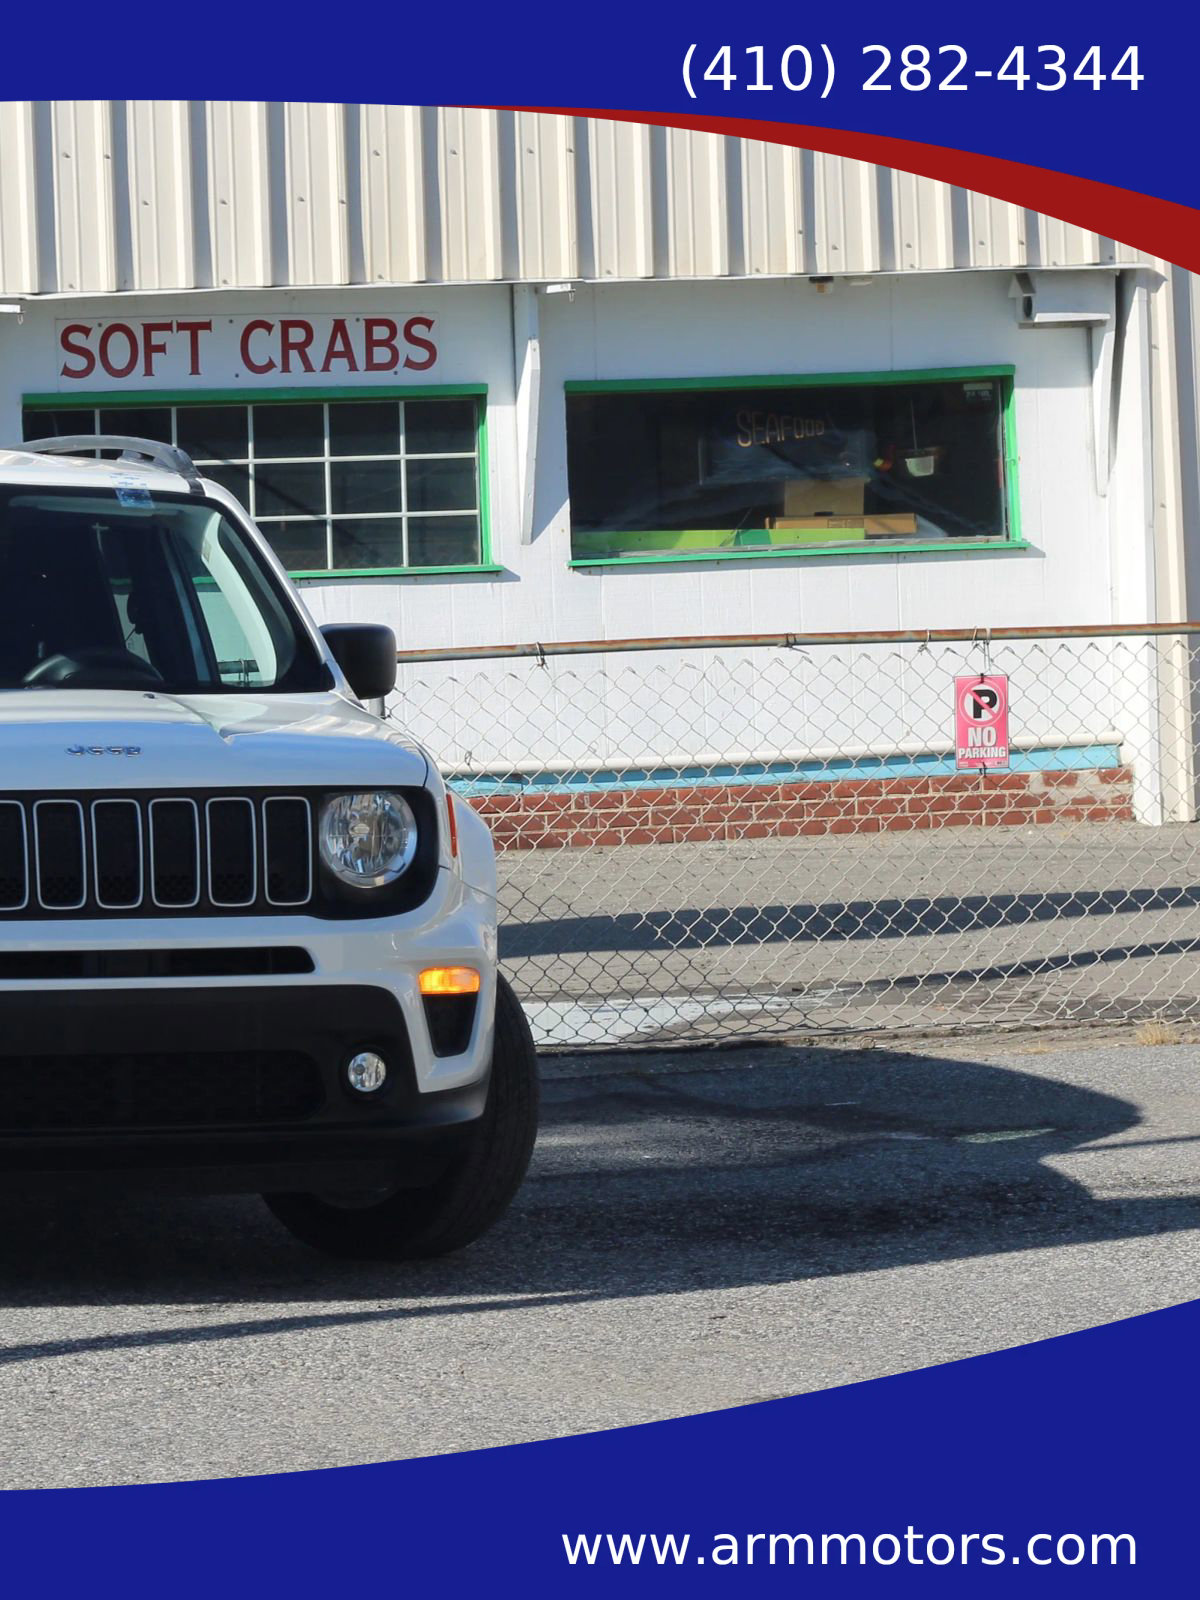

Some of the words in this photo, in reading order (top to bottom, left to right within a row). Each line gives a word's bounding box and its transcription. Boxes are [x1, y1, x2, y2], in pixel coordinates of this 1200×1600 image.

[60, 319, 213, 379] SOFT
[240, 316, 438, 375] CRABS
[967, 725, 997, 747] NO
[958, 746, 1007, 759] PARKING
